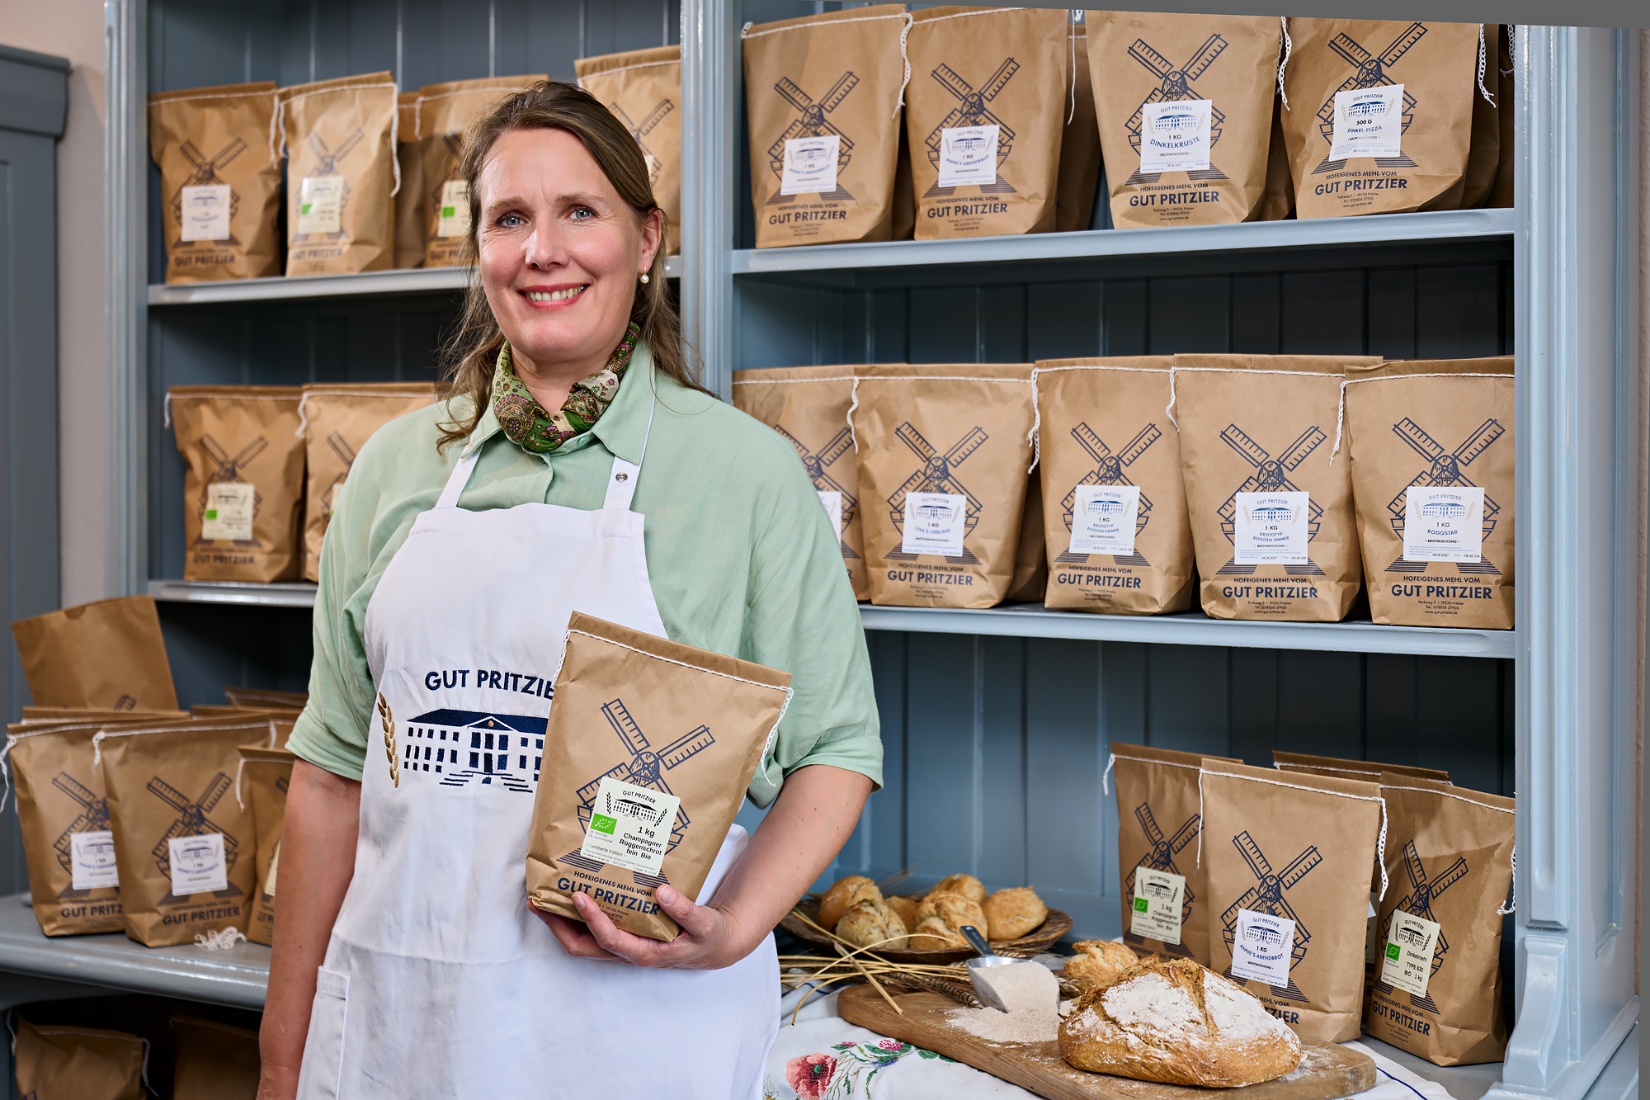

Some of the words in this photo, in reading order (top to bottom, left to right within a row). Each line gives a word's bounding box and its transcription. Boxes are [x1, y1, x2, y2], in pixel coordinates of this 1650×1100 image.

[1150, 136, 1200, 148] DINKELKRUSTE
[1326, 172, 1362, 180] HOFEIGENES
[1315, 182, 1341, 195] GUT
[1344, 178, 1408, 192] PRITZIER
[1130, 194, 1156, 206] GUT
[1160, 191, 1220, 205] PRITZIER
[769, 213, 792, 224] GUT
[794, 210, 846, 222] PRITZIER
[928, 206, 951, 218] GUT
[954, 204, 1008, 216] PRITZIER
[308, 248, 342, 258] PRITZIER
[174, 256, 194, 266] GUT
[195, 256, 236, 266] PRITZIER
[193, 555, 210, 564] GUT
[213, 555, 255, 564] PRITZIER
[888, 571, 914, 581] GUT
[918, 572, 973, 586] PRITZIER
[1058, 573, 1083, 585] GUT
[1086, 575, 1141, 588] PRITZIER
[1223, 586, 1251, 598] GUT
[1256, 586, 1318, 598] PRITZIER
[1392, 584, 1422, 596] GUT
[1426, 586, 1492, 599] PRITZIER
[425, 670, 470, 690] GUT
[477, 670, 554, 700] PRITZIE
[635, 792, 656, 804] PRITZIER
[645, 828, 655, 838] kg
[620, 839, 662, 855] Roggenschrot
[624, 833, 662, 848] Champagner
[574, 871, 616, 888] HOFEIGENES
[616, 883, 635, 893] MEHL
[636, 888, 652, 897] VOM
[558, 878, 592, 894] GUT
[594, 888, 660, 915] PRITZIER
[61, 906, 87, 918] GUT
[90, 904, 123, 916] PRITZ
[163, 914, 188, 925] GUT
[192, 907, 240, 922] PRITZIER
[1263, 919, 1280, 928] PRITZIER
[1407, 951, 1427, 962] Dinkelmehl
[1406, 962, 1416, 970] TYPE
[1373, 1001, 1388, 1017] GUT
[1390, 1009, 1430, 1036] PRITZIER
[1412, 1009, 1424, 1018] VOM
